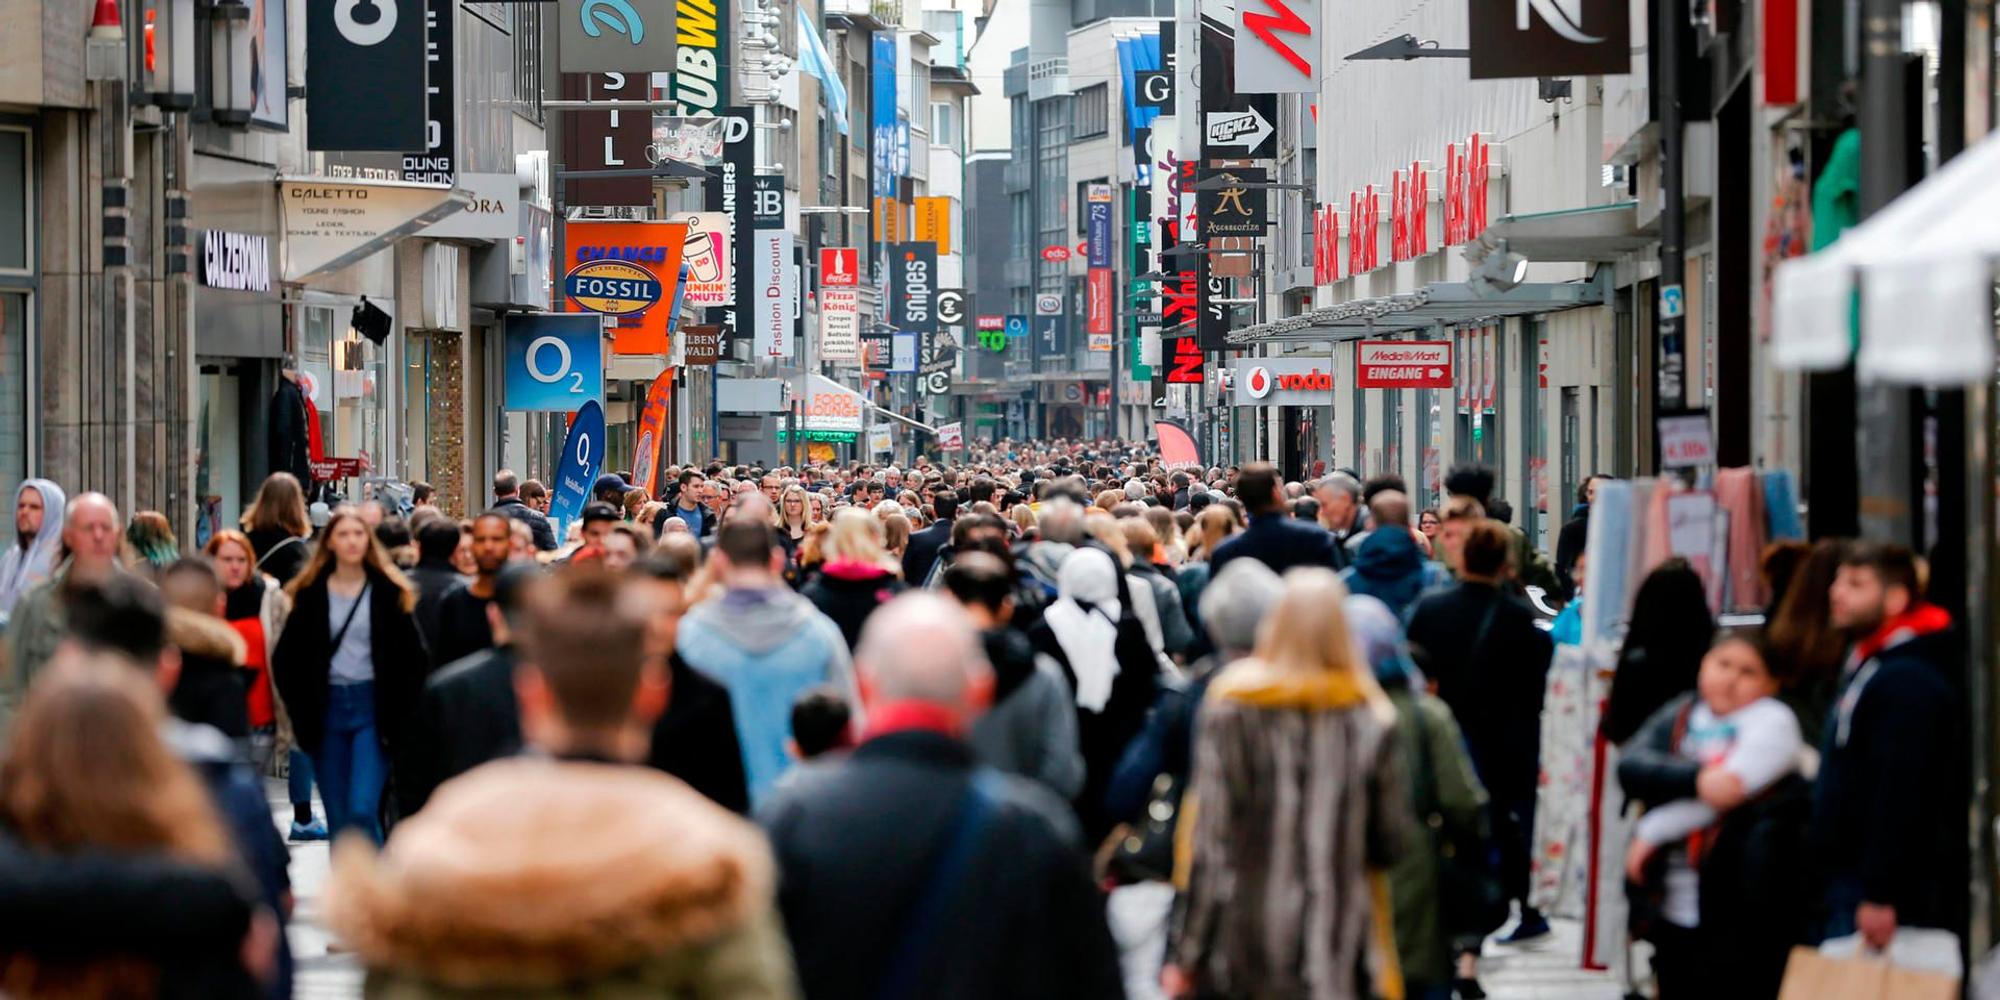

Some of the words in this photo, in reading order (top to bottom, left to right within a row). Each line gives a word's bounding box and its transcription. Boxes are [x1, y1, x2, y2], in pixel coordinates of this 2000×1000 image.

[676, 0, 718, 117] SUBWA
[1144, 75, 1170, 102] G
[403, 157, 449, 170] OUNG
[405, 172, 455, 184] SHION
[291, 188, 368, 200] CALETTO
[1207, 220, 1260, 233] Accessorize
[204, 229, 271, 292] CALZEDONIA
[576, 245, 668, 263] CHANGE
[584, 266, 645, 278] AUTHENTIC
[766, 238, 782, 298] Discount
[575, 278, 653, 300] FOSSIL
[685, 283, 727, 292] UNKIN'
[905, 260, 931, 322] snipes
[684, 293, 724, 302] ONUTS
[825, 292, 854, 300] Pizza
[823, 302, 856, 313] König
[768, 303, 782, 356] Fashion
[685, 335, 716, 345] LBEN
[1367, 367, 1423, 380] EINGANG
